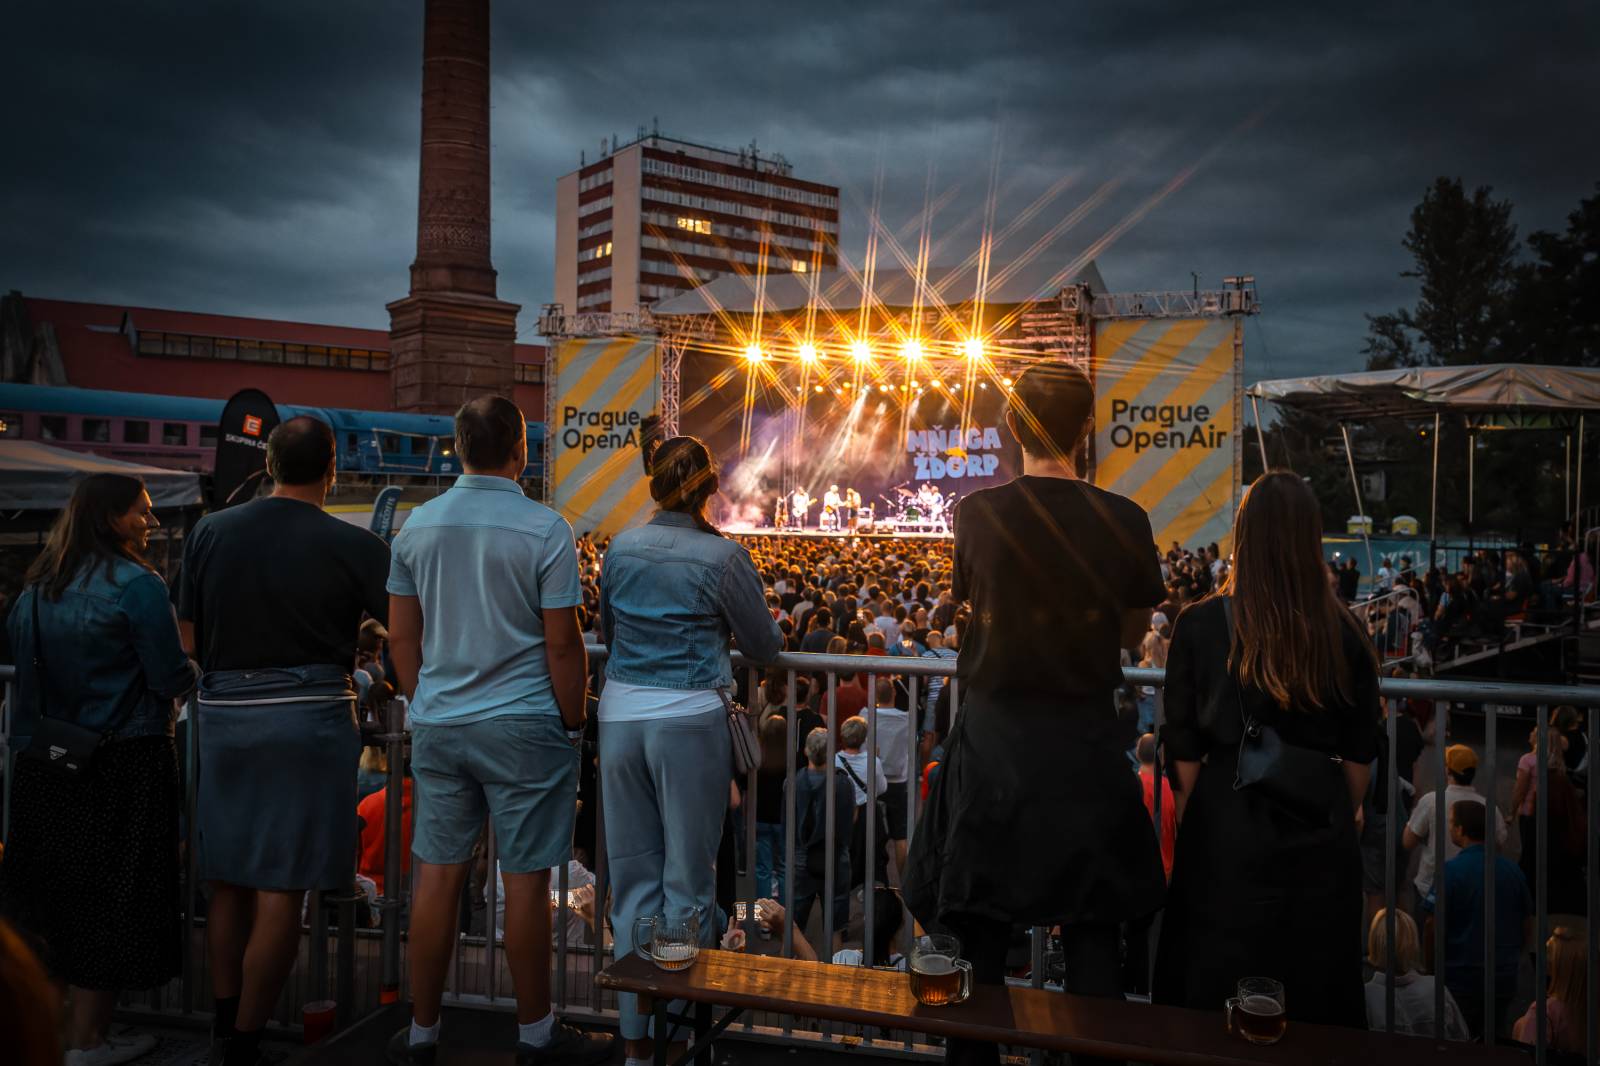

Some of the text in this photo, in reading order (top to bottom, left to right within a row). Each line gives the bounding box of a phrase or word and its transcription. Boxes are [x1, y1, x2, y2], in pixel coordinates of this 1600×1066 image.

[564, 406, 640, 431] Prague
[1111, 399, 1210, 428] Prague
[563, 428, 642, 453] OpenA
[1110, 424, 1227, 453] OpenAir
